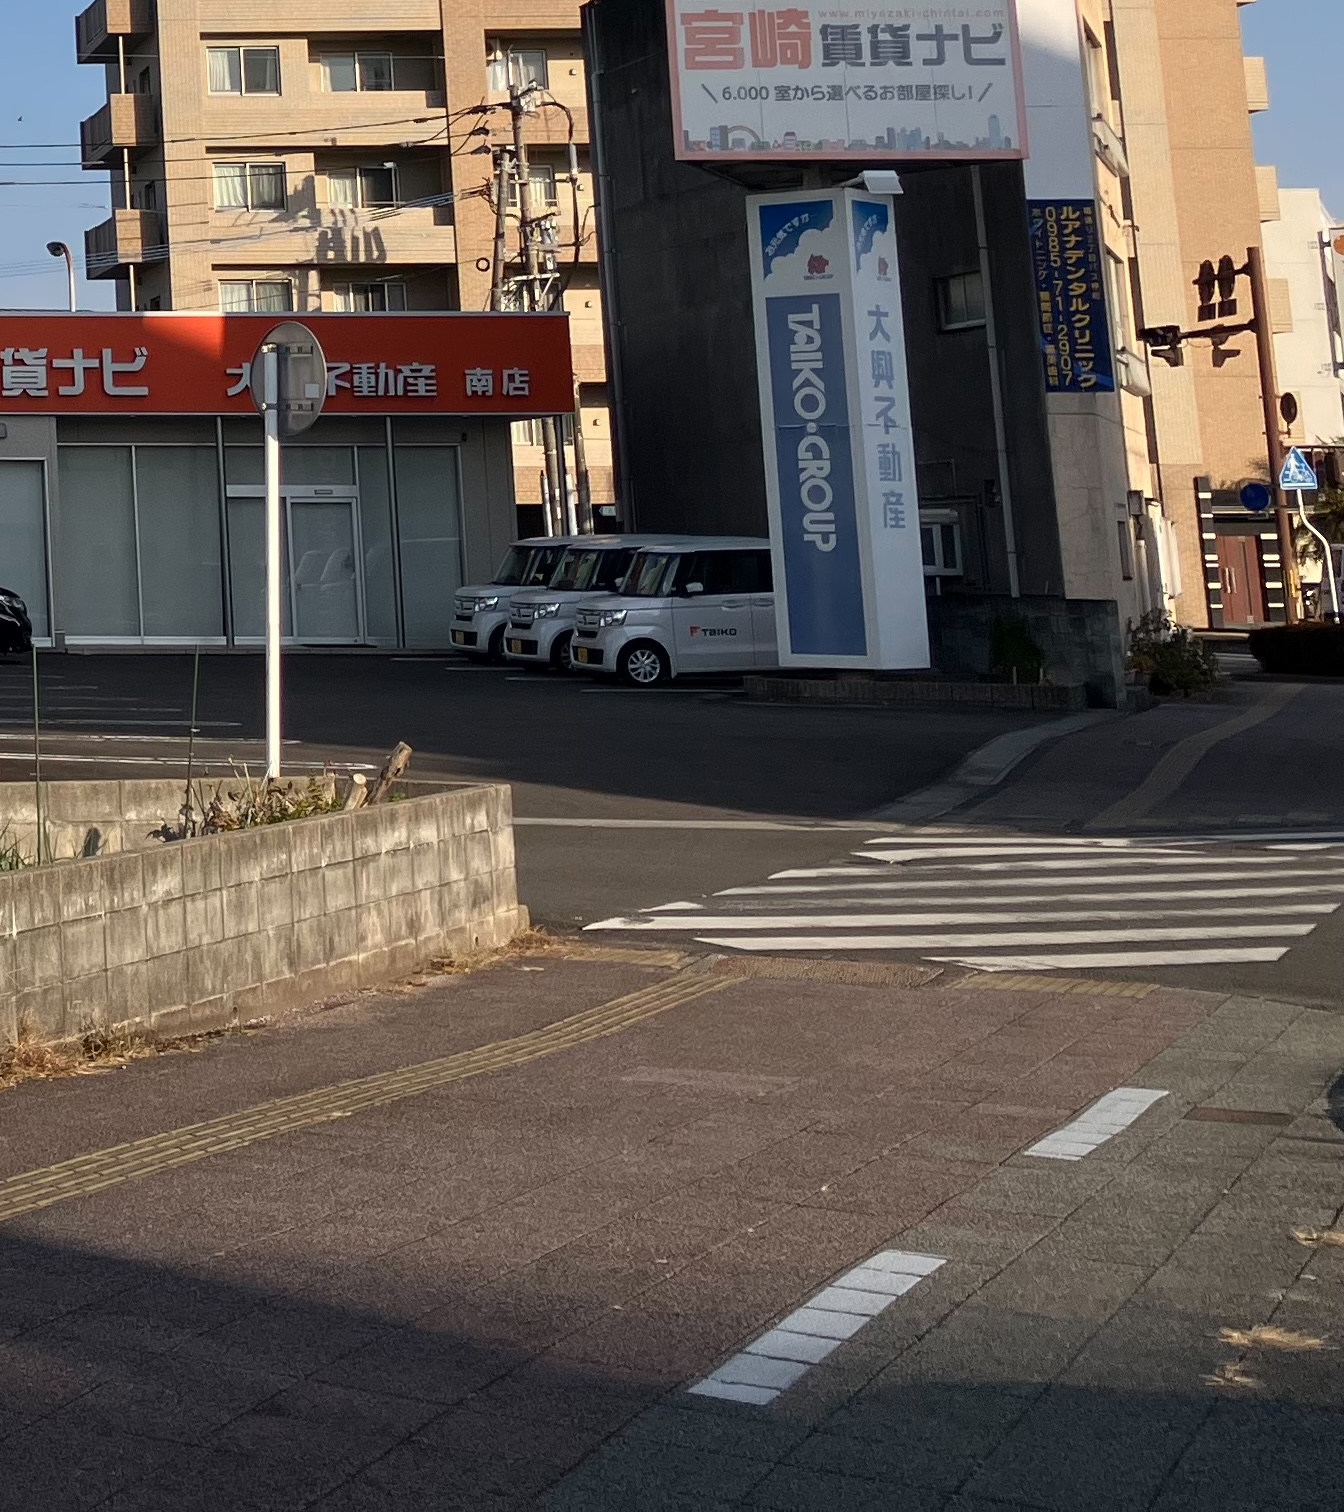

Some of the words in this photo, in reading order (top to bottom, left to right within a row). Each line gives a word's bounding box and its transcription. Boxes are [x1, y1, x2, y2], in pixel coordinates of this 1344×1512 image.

[464, 366, 530, 398] 南店
[1061, 206, 1097, 387] ルアナデンタルクリニック
[867, 304, 906, 529] 大興不動産
